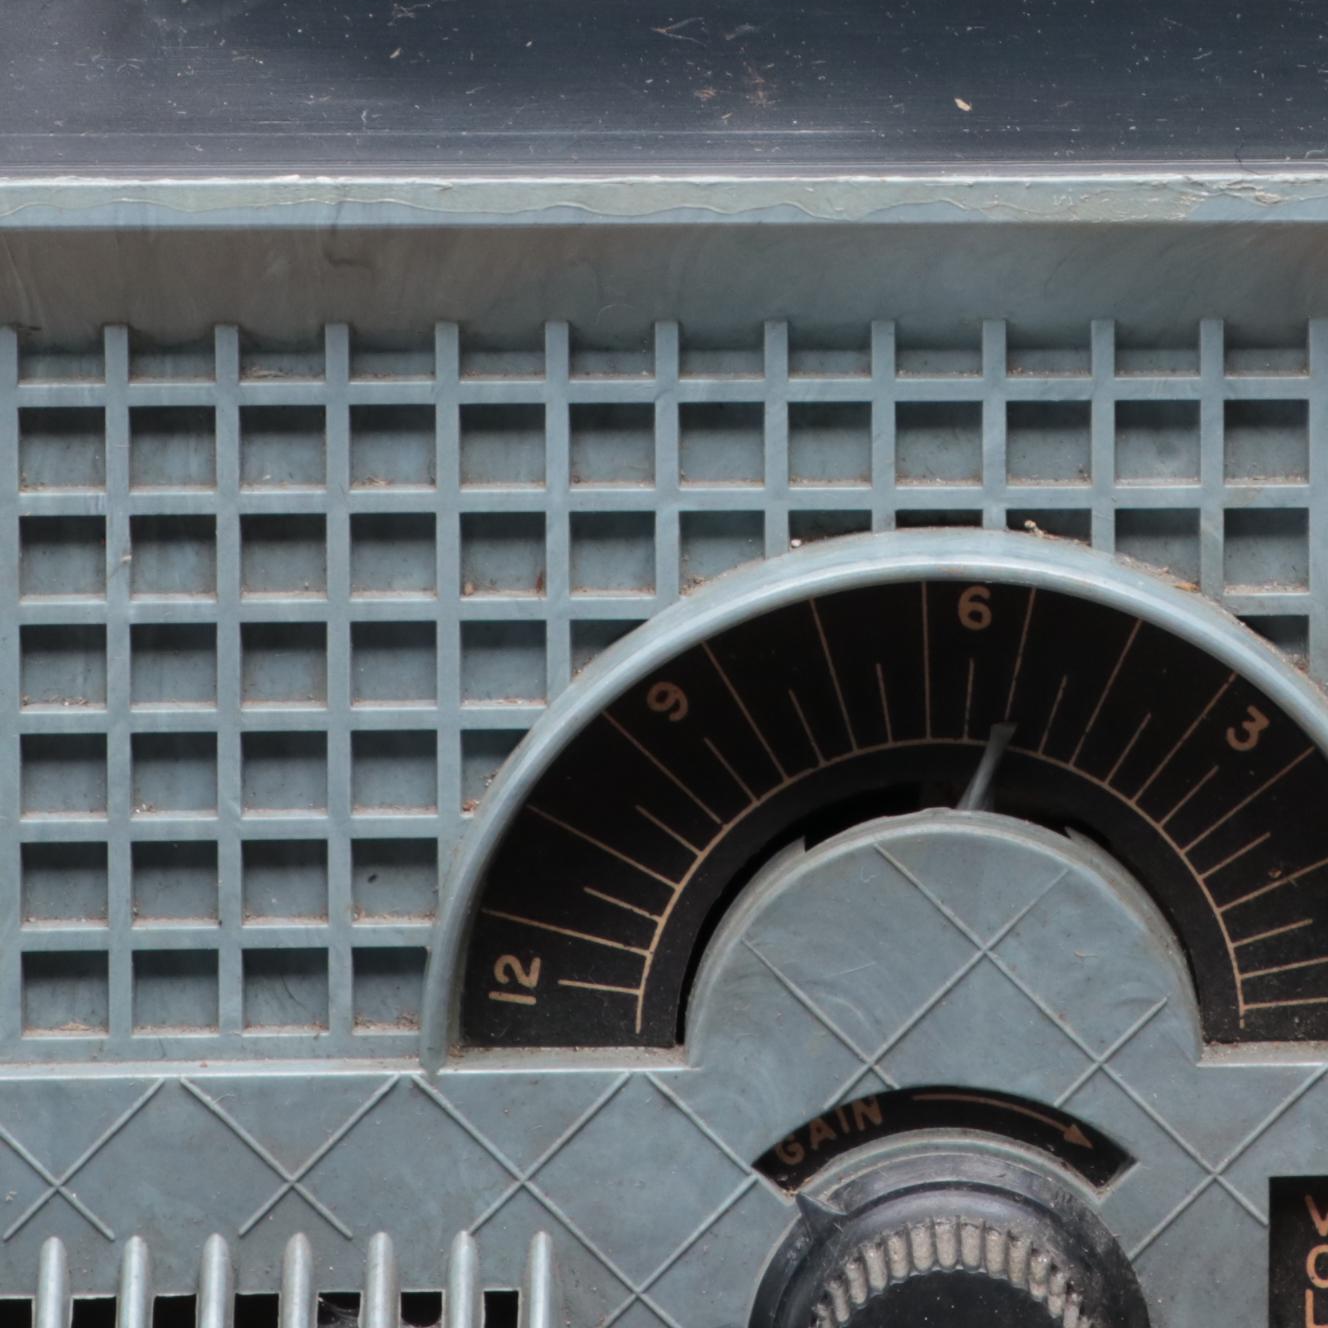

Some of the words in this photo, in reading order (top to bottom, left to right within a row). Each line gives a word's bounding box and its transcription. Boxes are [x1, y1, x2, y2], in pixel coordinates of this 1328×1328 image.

[958, 584, 993, 631] 6
[1226, 705, 1270, 752] 3
[488, 953, 542, 1006] 12
[774, 1094, 884, 1166] GAIN
